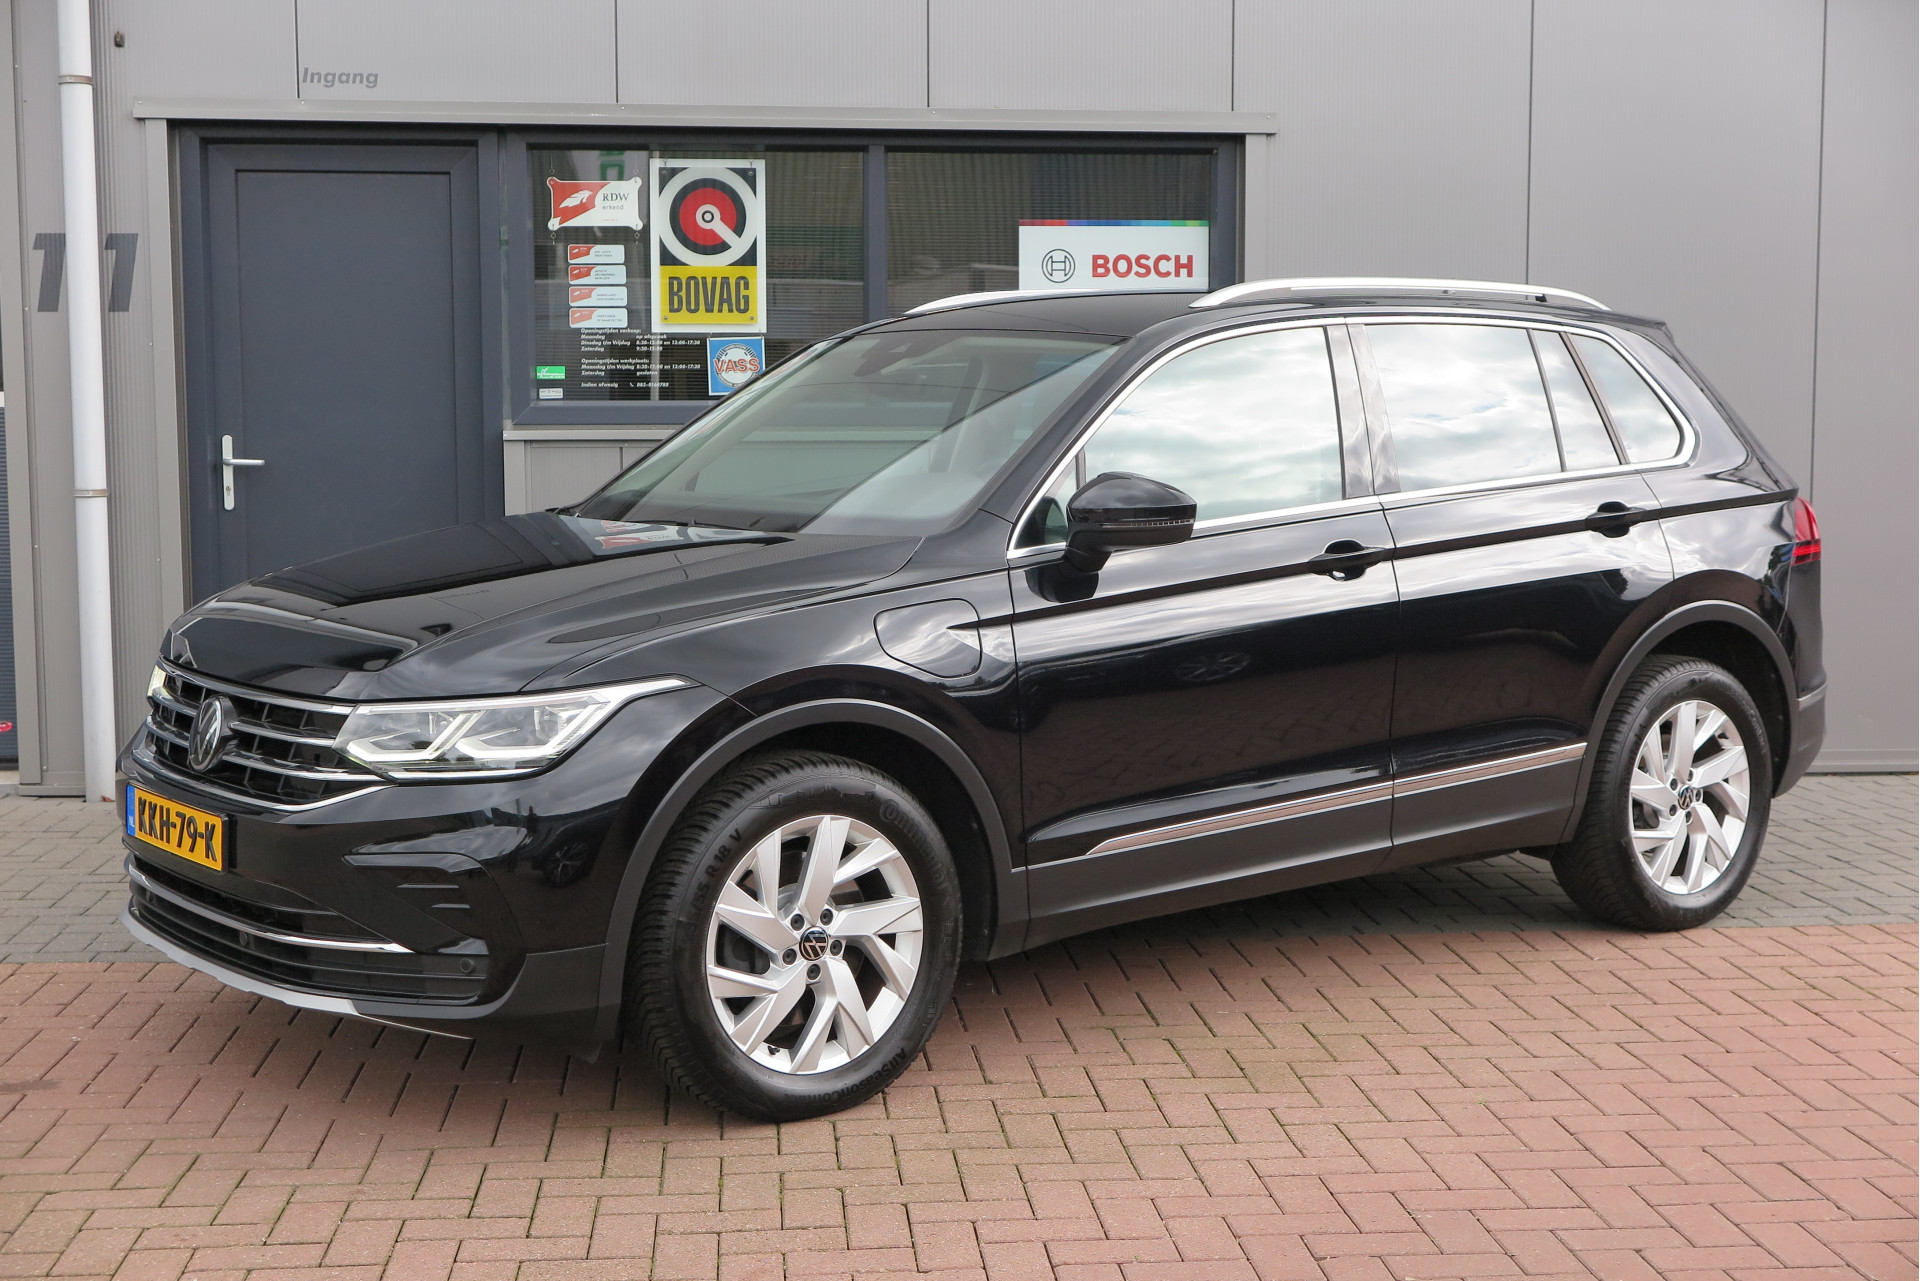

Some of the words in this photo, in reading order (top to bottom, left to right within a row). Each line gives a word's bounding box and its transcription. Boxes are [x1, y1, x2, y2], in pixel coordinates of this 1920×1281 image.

[302, 67, 379, 89] Ingang
[602, 193, 631, 202] RDW
[32, 232, 139, 313] 11
[1091, 253, 1194, 279] BOSCH
[667, 275, 751, 315] BOVAG
[713, 358, 760, 373] VASS
[138, 796, 218, 863] KKH-79-K
